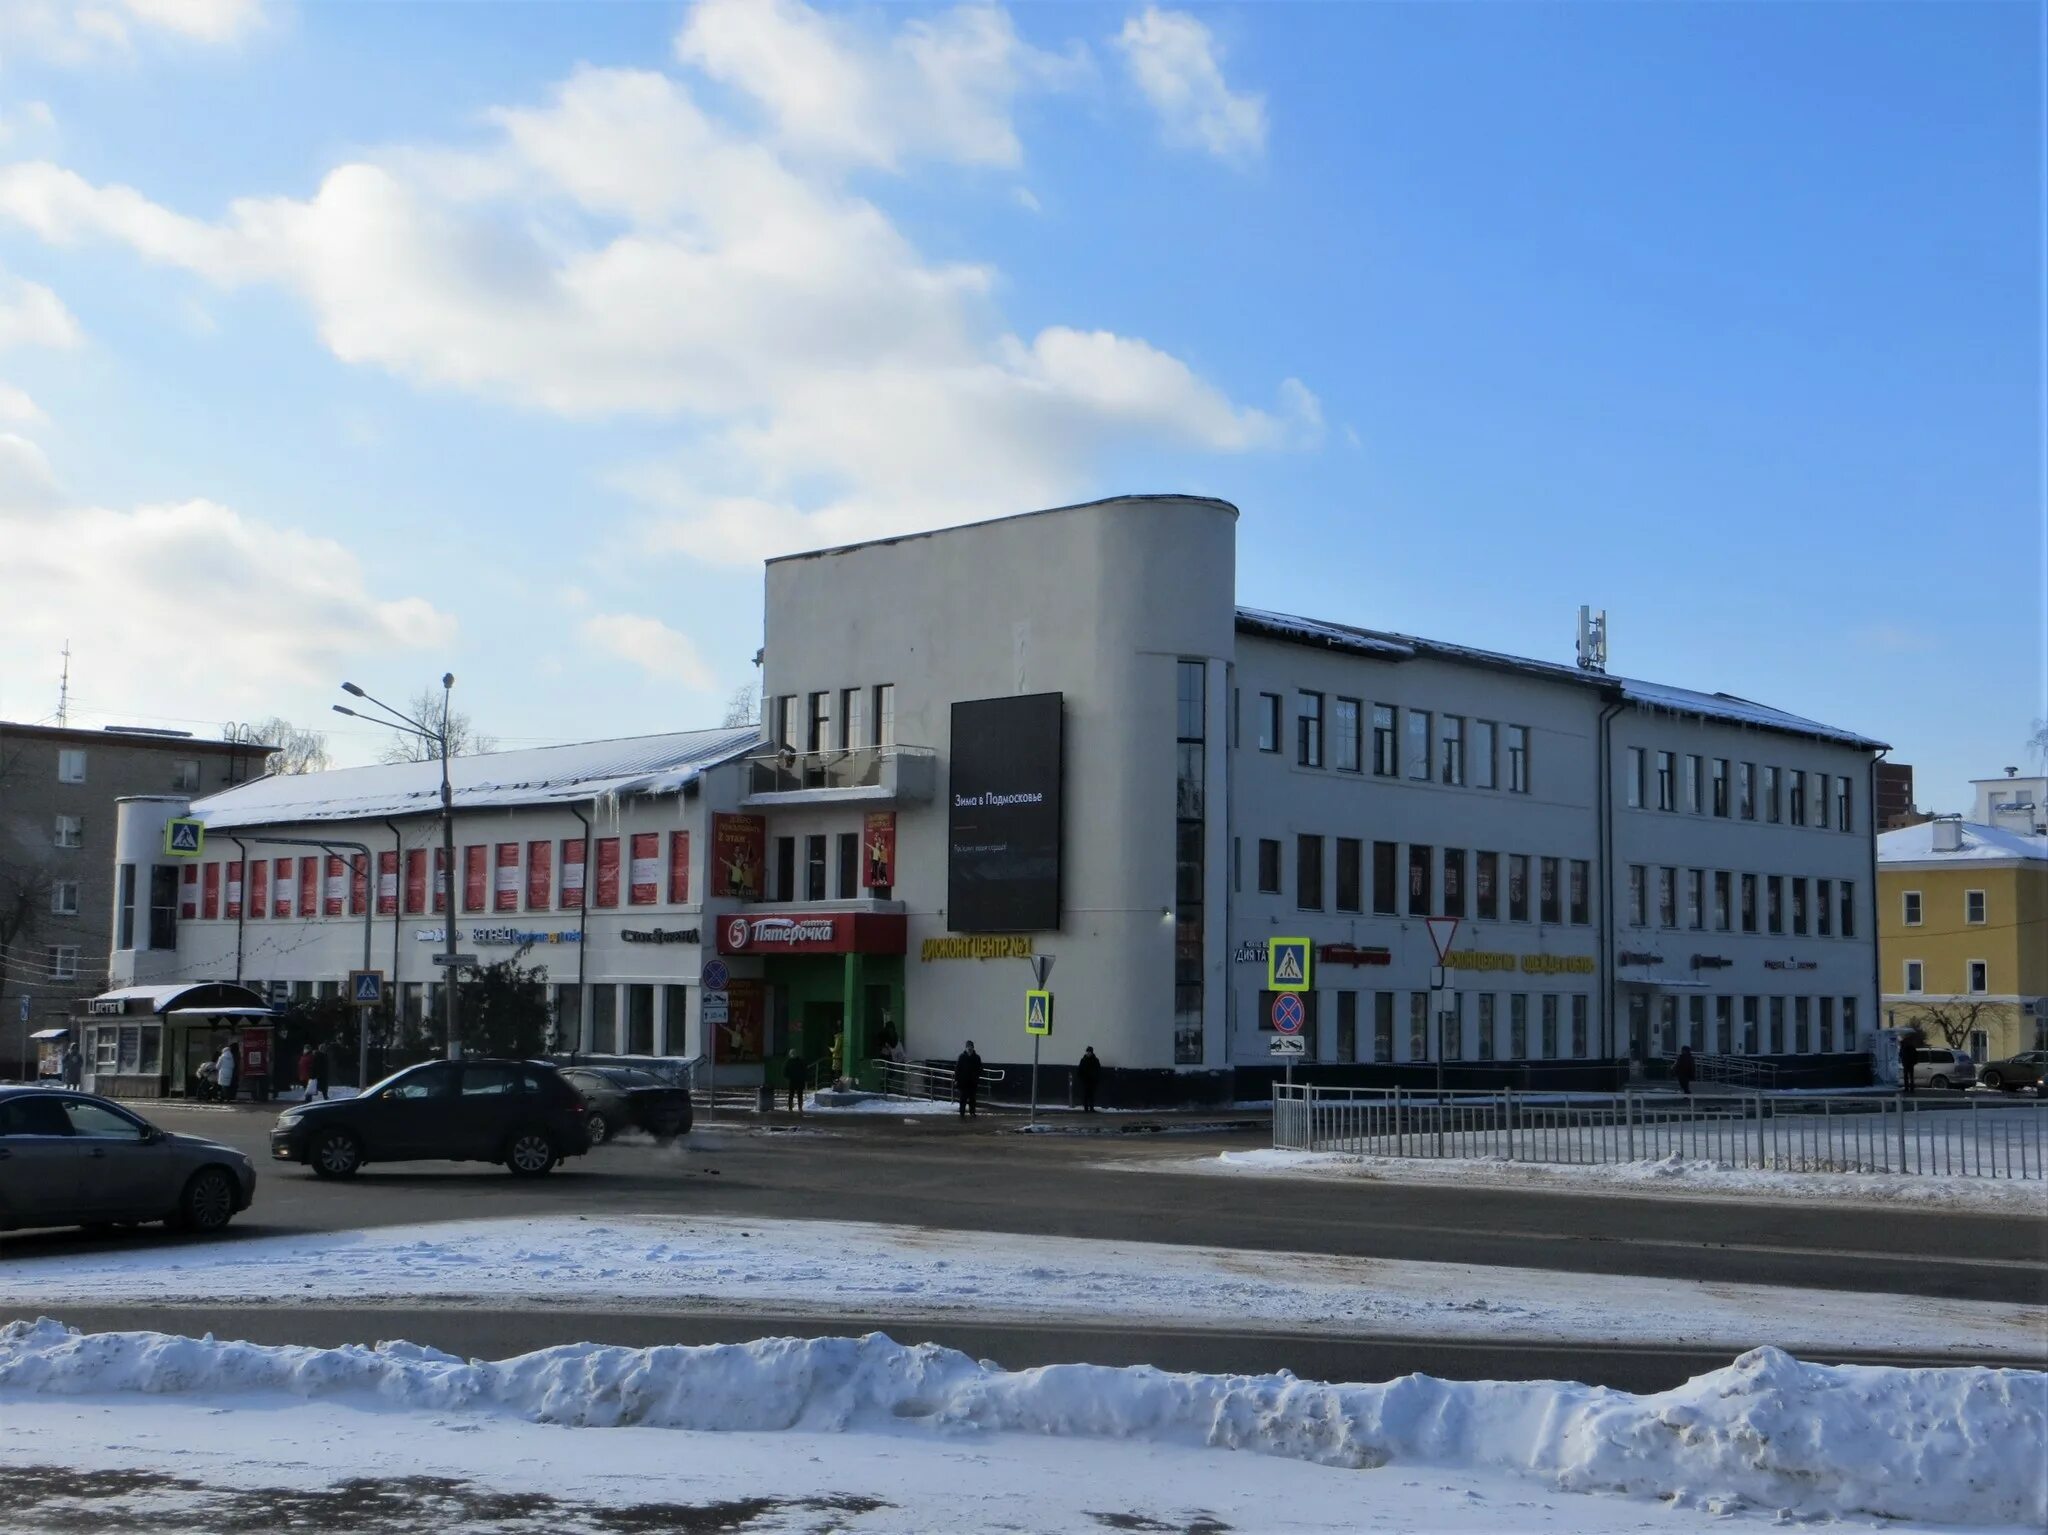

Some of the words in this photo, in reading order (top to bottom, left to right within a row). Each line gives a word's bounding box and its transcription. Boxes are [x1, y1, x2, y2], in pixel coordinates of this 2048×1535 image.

[955, 794, 977, 807] Зима
[979, 796, 984, 806] в
[985, 792, 1043, 806] Подмосковье
[922, 938, 971, 962] ДИСКОНТ
[972, 937, 1008, 960] ЦЕНТР
